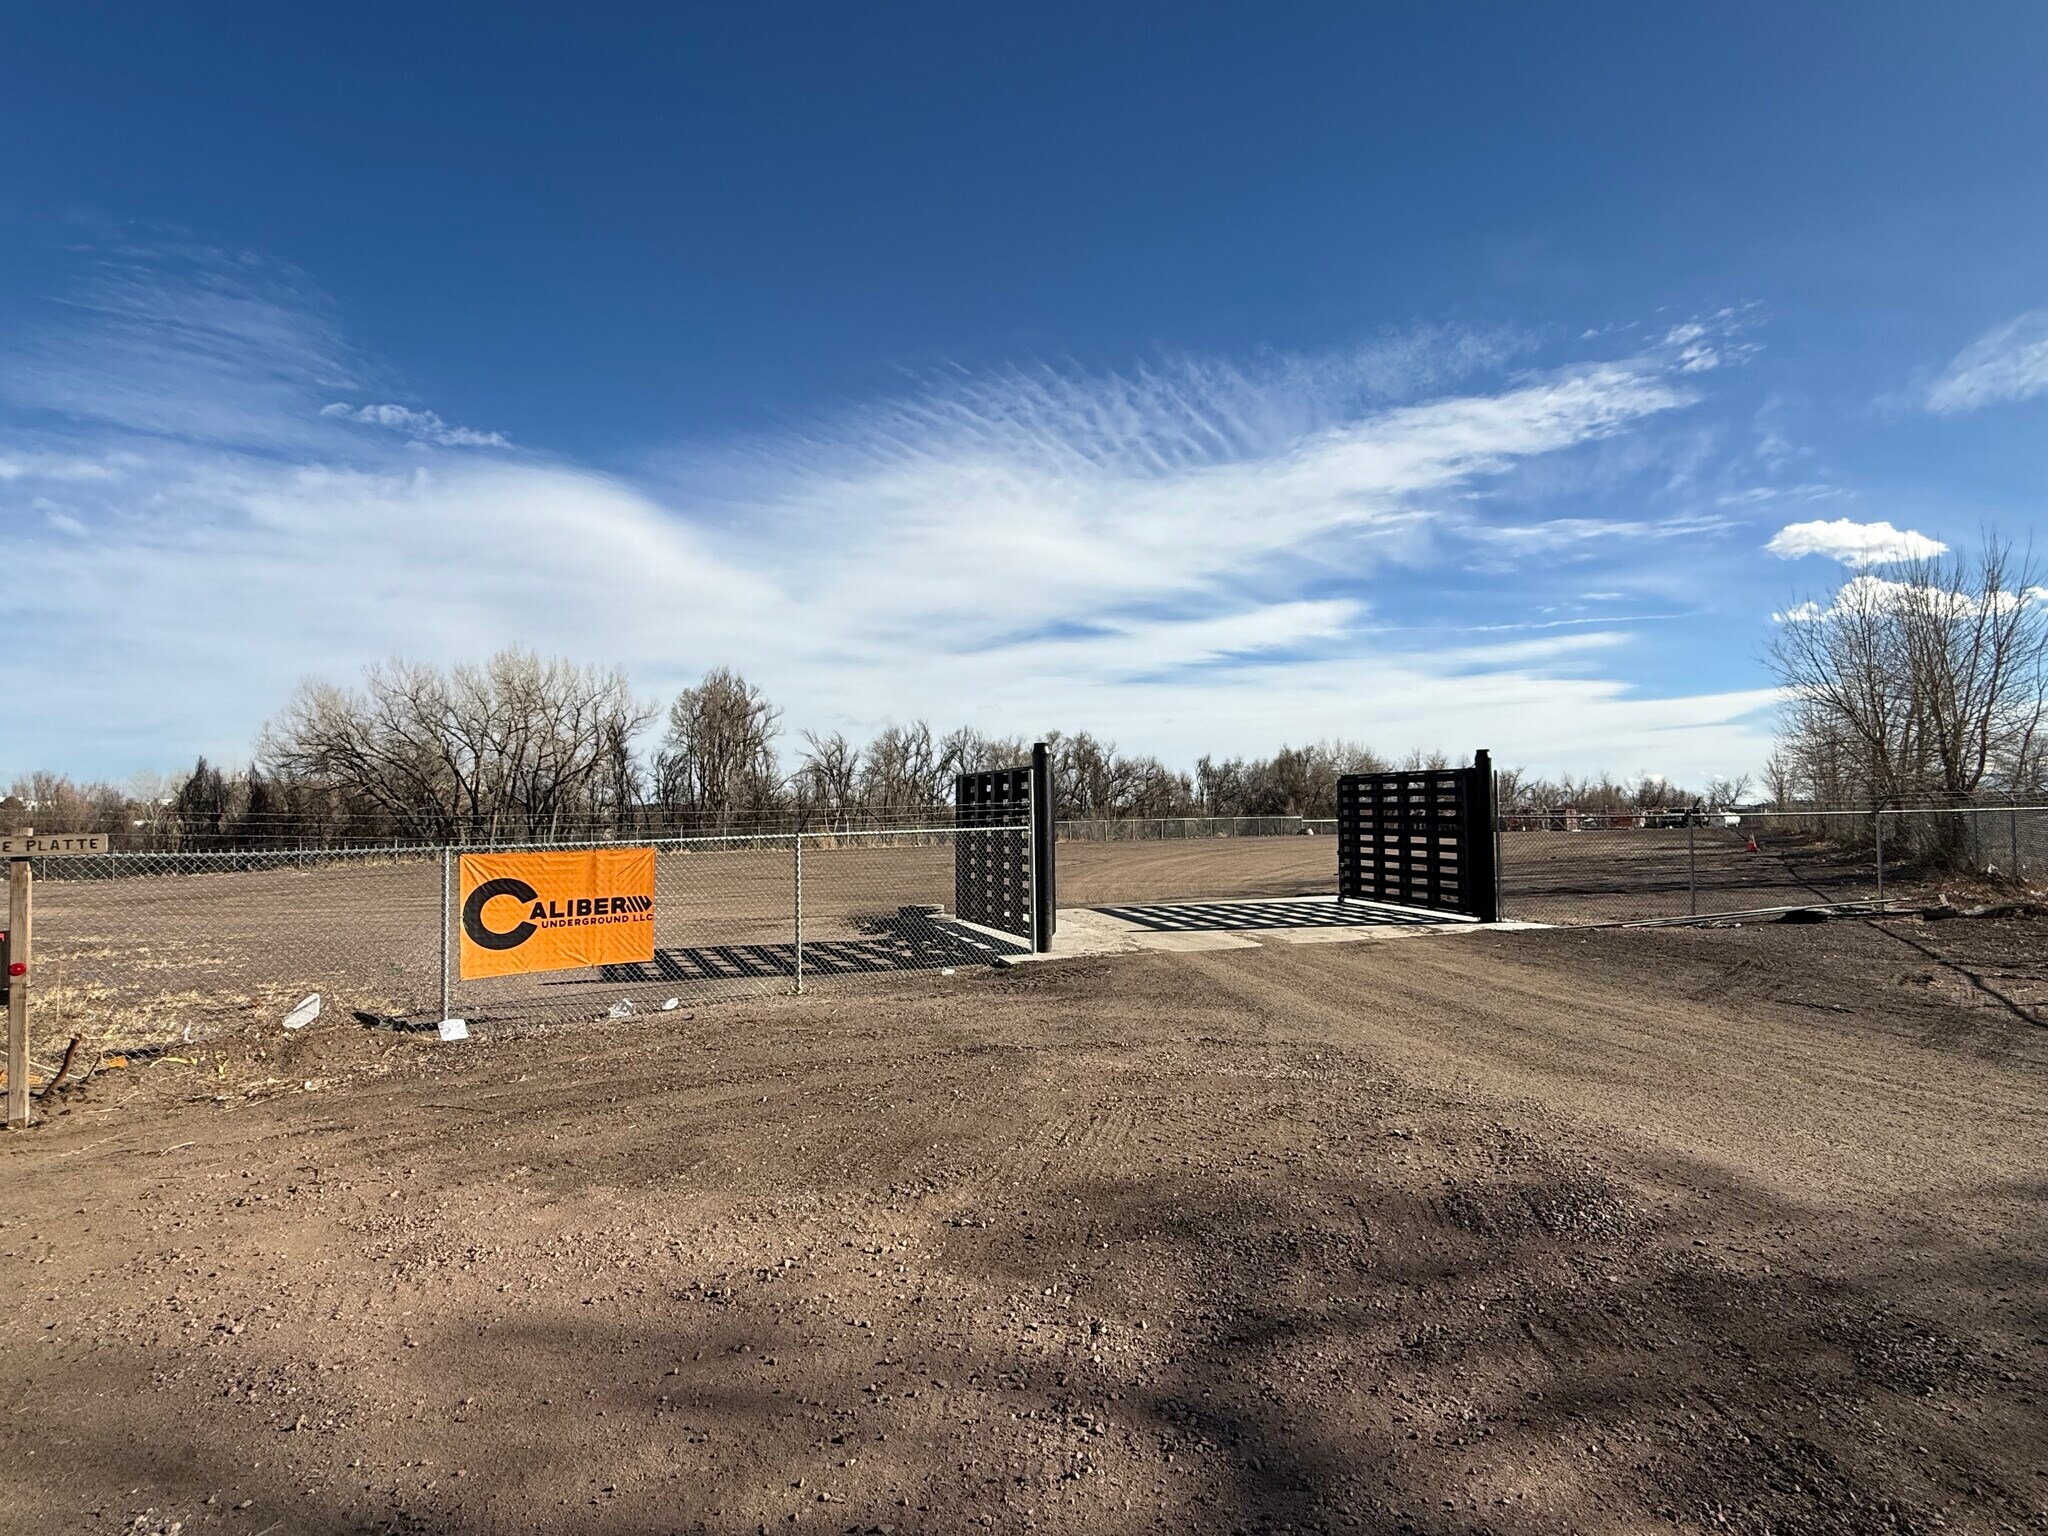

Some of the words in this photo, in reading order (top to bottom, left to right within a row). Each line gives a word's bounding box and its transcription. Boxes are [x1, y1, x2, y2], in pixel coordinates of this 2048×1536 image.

[26, 838, 99, 851] PLATTE
[462, 877, 628, 950] CALIBER
[541, 915, 629, 928] UNDERGROUND
[632, 913, 654, 922] LLC
